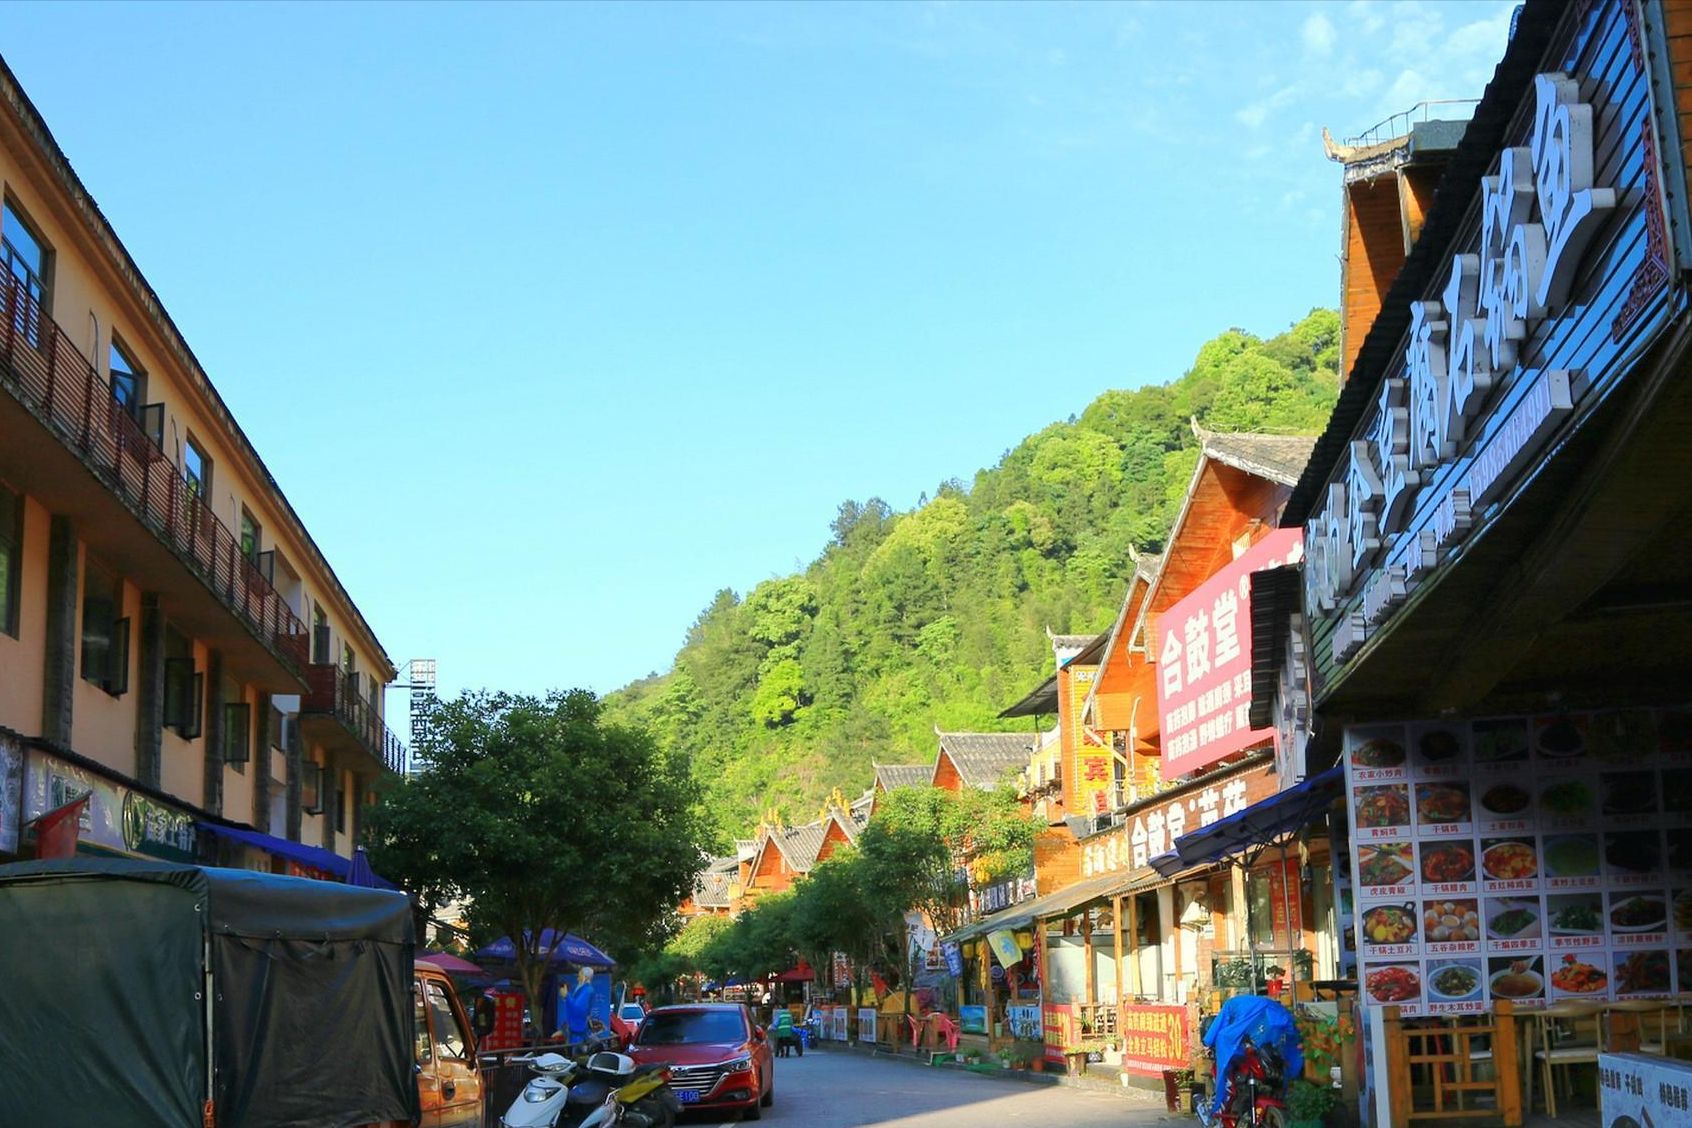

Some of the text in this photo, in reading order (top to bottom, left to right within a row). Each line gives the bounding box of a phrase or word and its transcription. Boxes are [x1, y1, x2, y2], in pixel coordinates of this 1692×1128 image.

[1370, 886, 1406, 896] 虎皮青椒
[1369, 945, 1413, 955] 干锅土豆片
